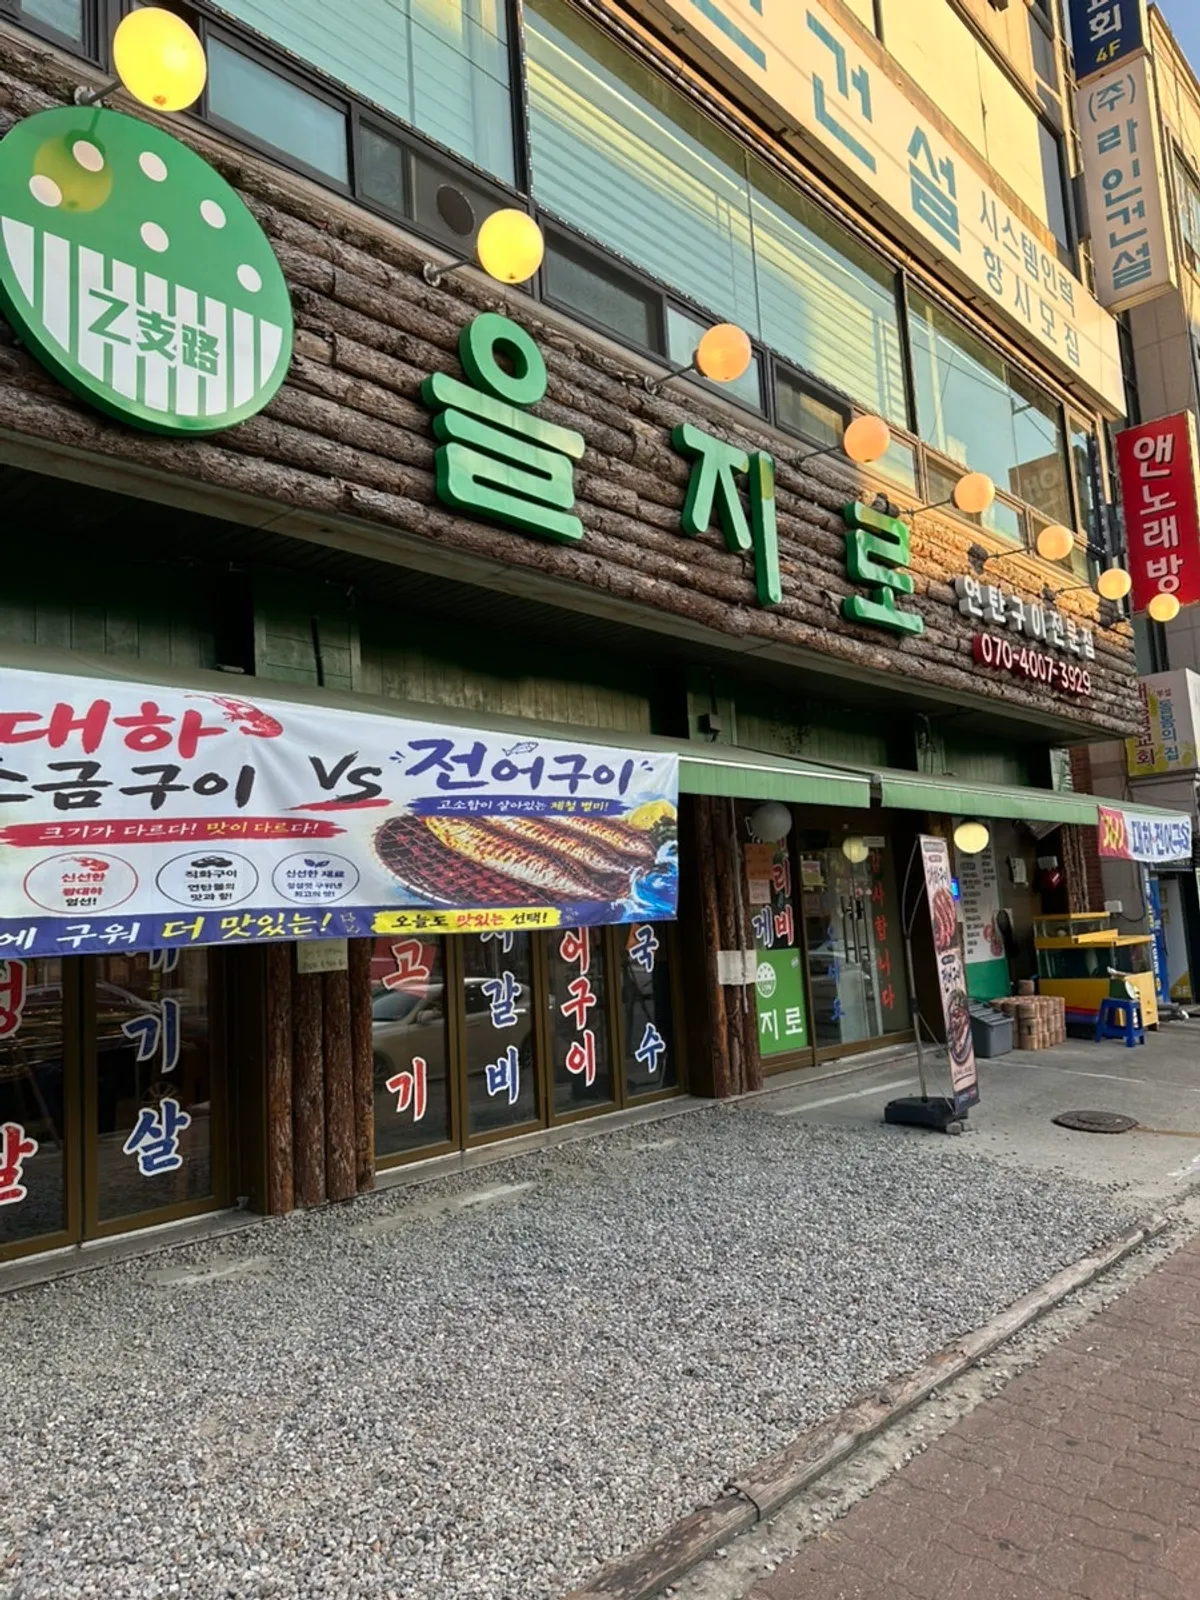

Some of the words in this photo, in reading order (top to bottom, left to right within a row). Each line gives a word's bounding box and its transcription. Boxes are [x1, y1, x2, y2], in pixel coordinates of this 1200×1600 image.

[1096, 38, 1121, 62] 4F
[980, 190, 1075, 319] 시스템인력
[1133, 433, 1183, 594] 앤노래방
[956, 575, 1096, 660] 연탄구이전문점
[980, 632, 1092, 696] 070-4007-3929
[0, 697, 229, 760] 대하
[405, 737, 636, 798] 전어구이
[437, 800, 493, 812] 고소함이
[496, 800, 546, 812] 살아있는
[39, 823, 116, 841] 크기가
[123, 823, 198, 838] 다르다!
[206, 822, 248, 836] 맛이
[253, 822, 320, 836] 다르다!
[61, 872, 107, 883] 신선한
[56, 922, 141, 949] 구워
[161, 916, 205, 941] 더
[220, 912, 332, 939] 맛있는!
[391, 914, 449, 929] 오늘도
[456, 913, 505, 928] 맛있는
[510, 911, 548, 926] 선택!
